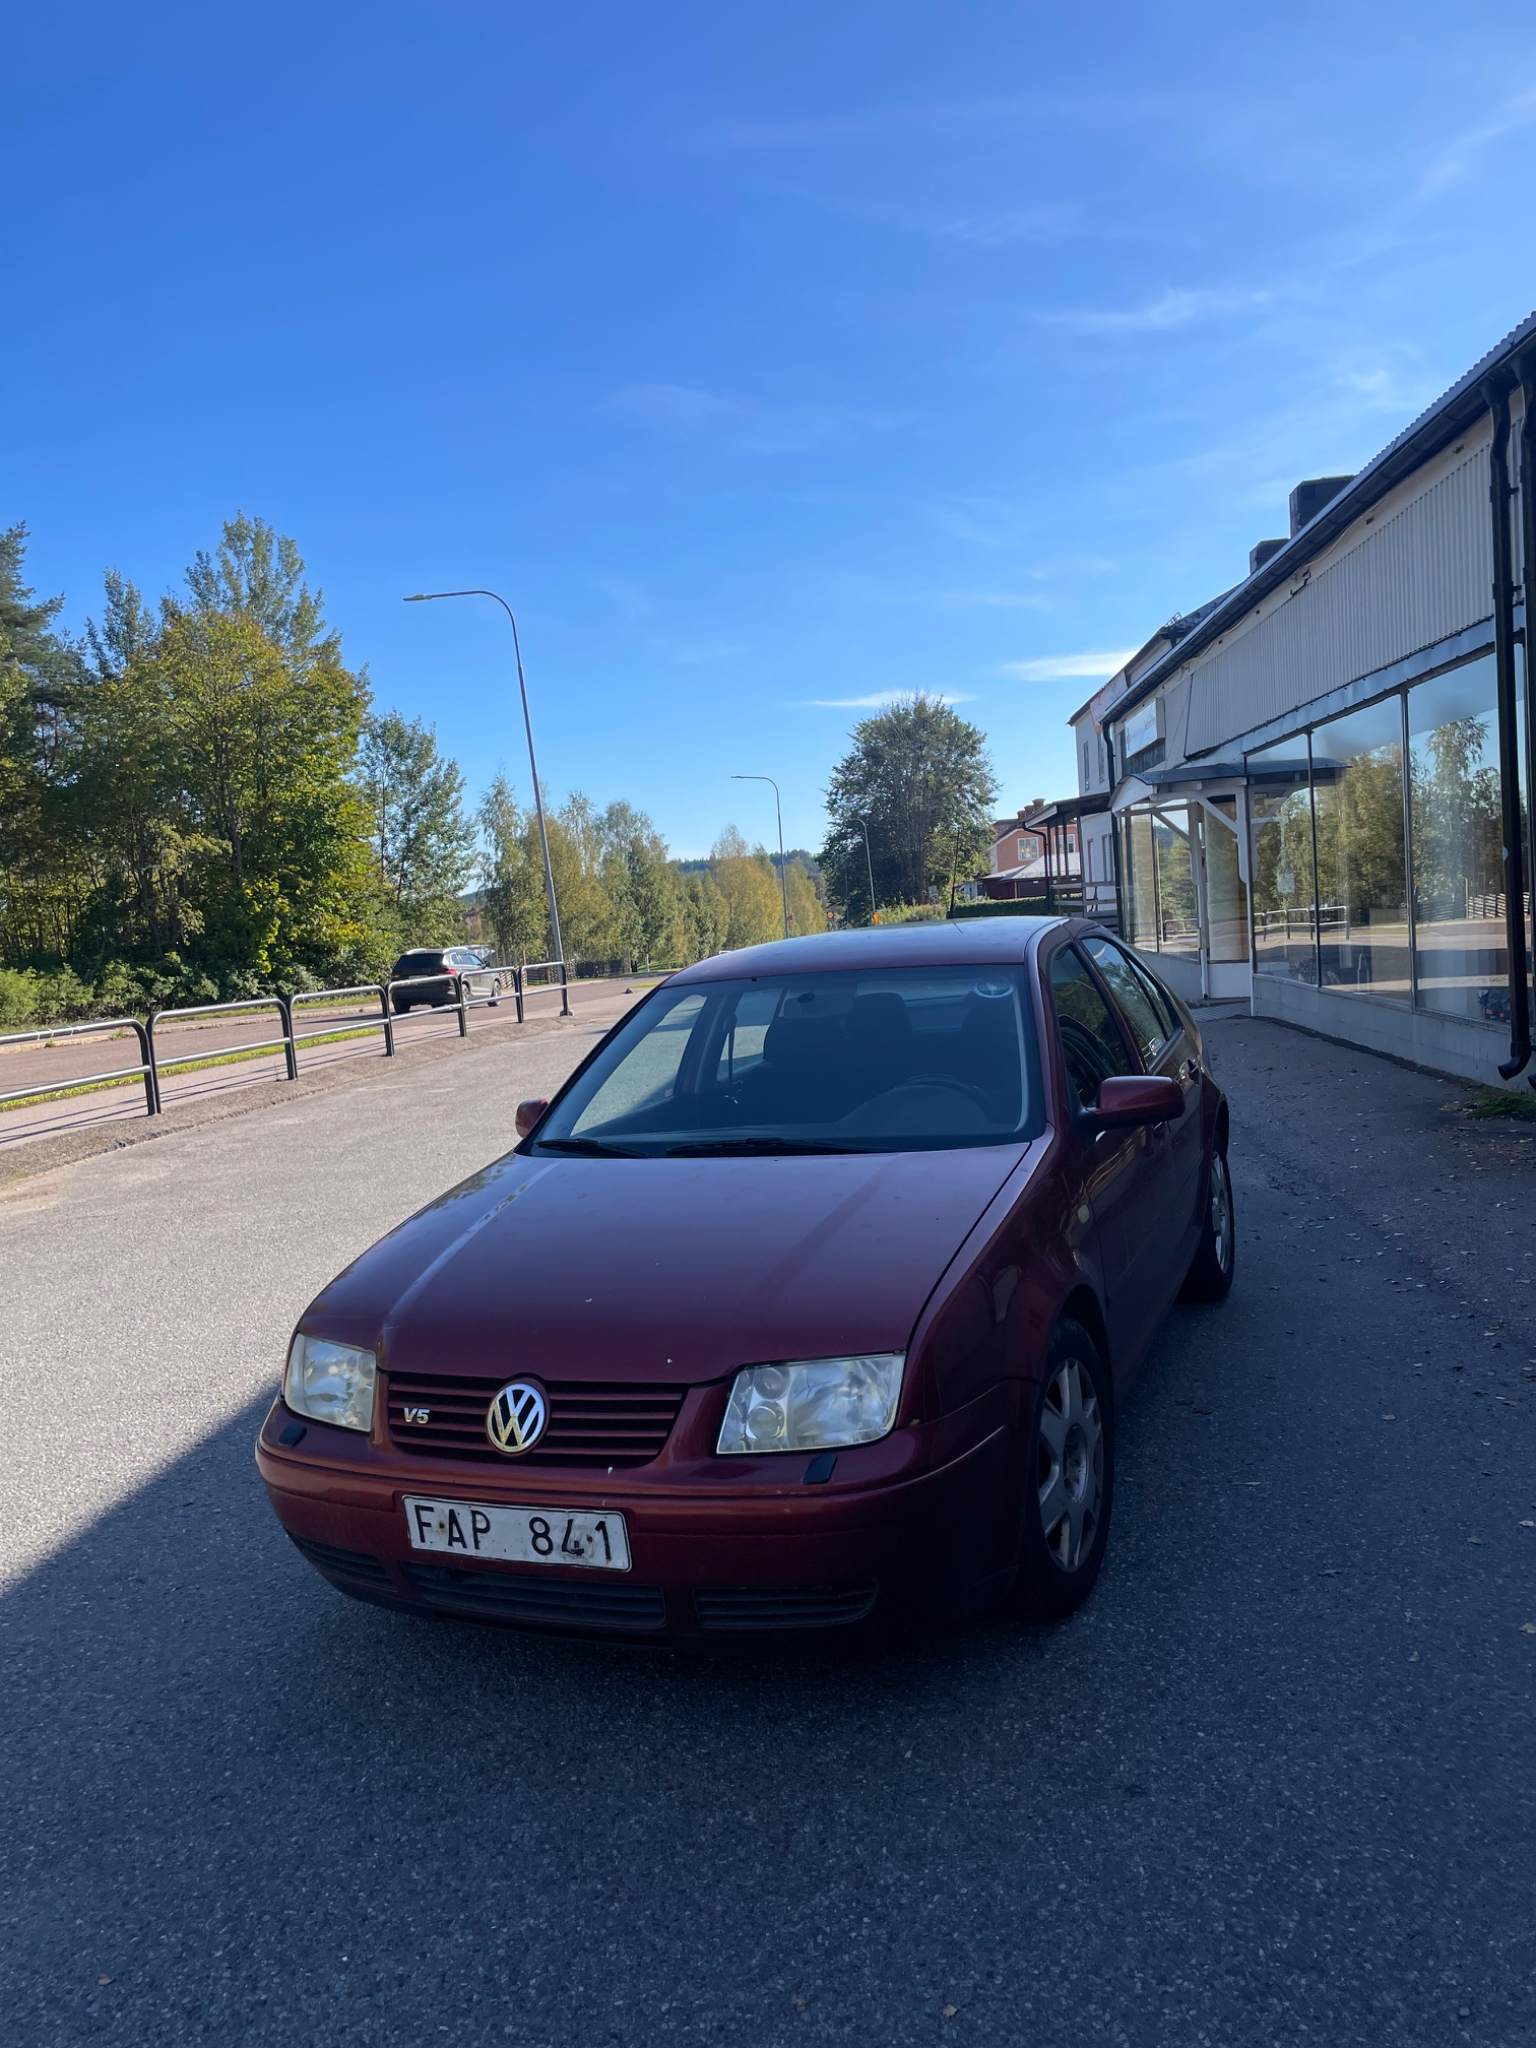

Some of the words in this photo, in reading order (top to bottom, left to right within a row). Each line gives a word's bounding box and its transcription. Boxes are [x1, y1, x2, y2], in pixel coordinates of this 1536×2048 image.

[403, 1407, 430, 1424] V5
[488, 1384, 545, 1452] VW
[414, 1504, 491, 1550] FAP
[528, 1516, 612, 1564] 841
